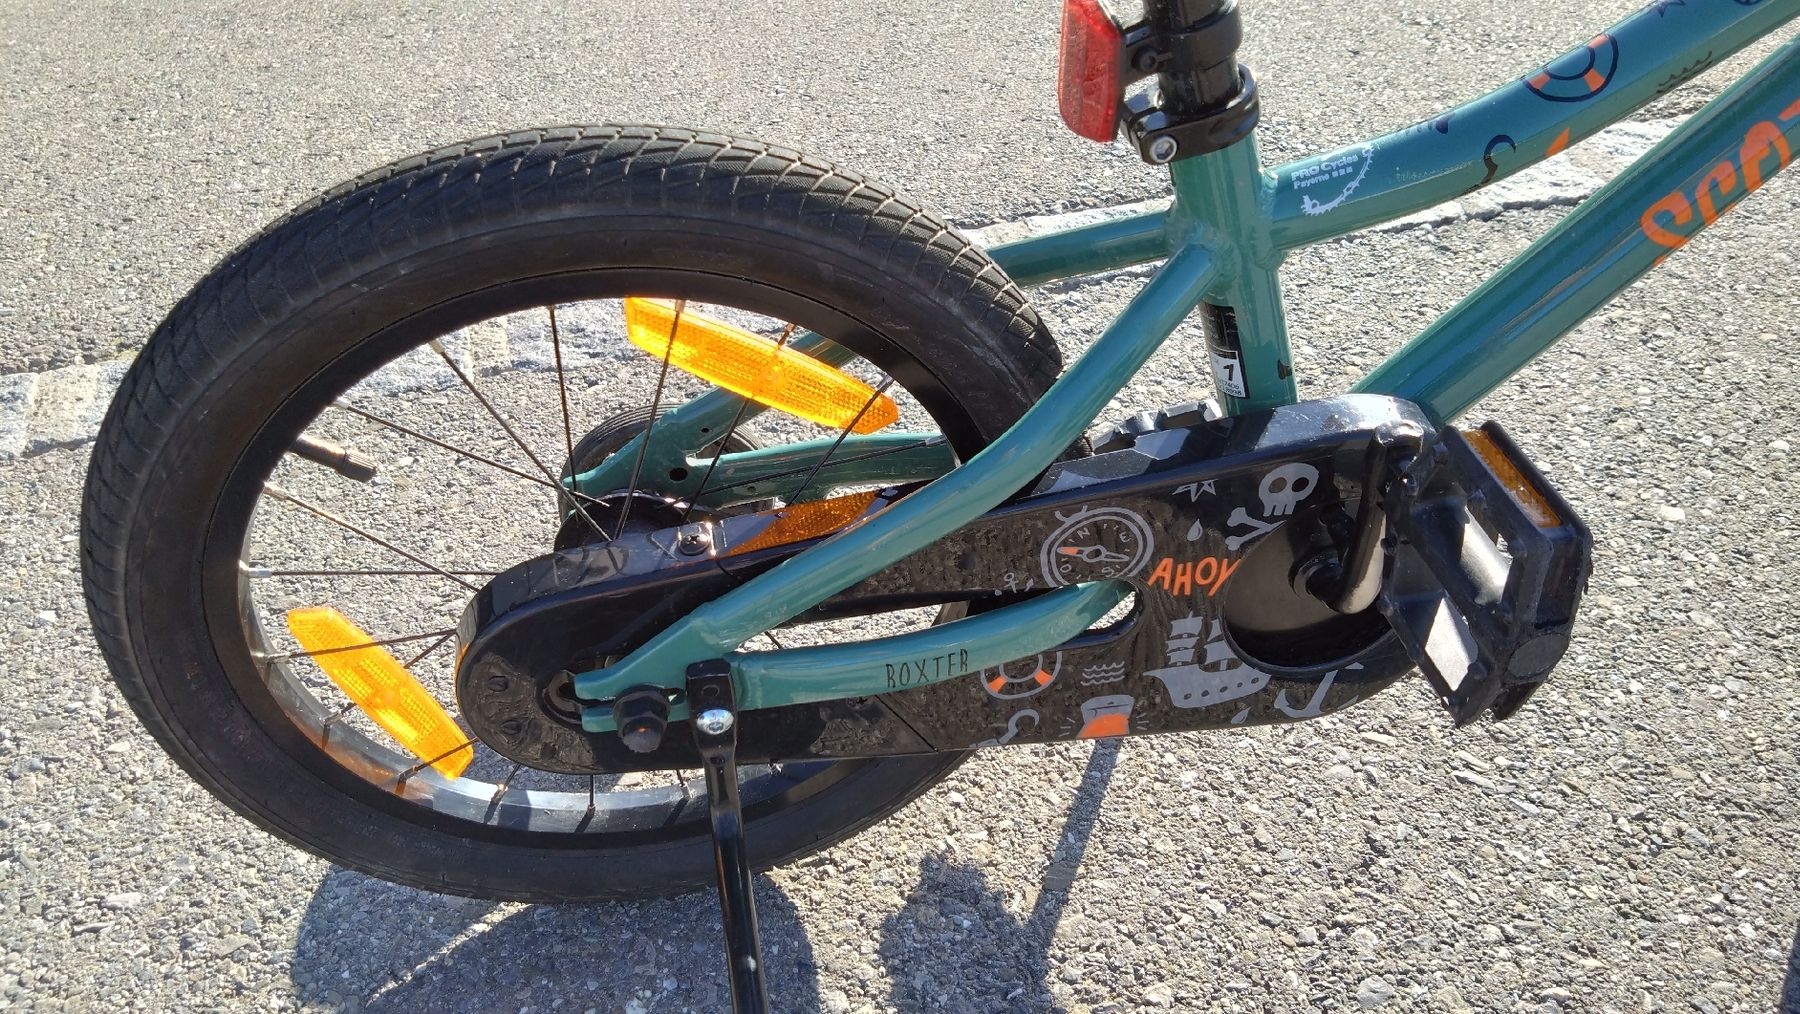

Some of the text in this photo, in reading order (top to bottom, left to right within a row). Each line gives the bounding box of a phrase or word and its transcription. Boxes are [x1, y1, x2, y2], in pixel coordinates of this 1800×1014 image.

[1290, 154, 1359, 181] PRO Cycles
[1293, 172, 1330, 190] Payerne
[1640, 97, 1800, 267] SCO
[1146, 556, 1242, 597] AHOY
[885, 648, 969, 689] ROXTER
